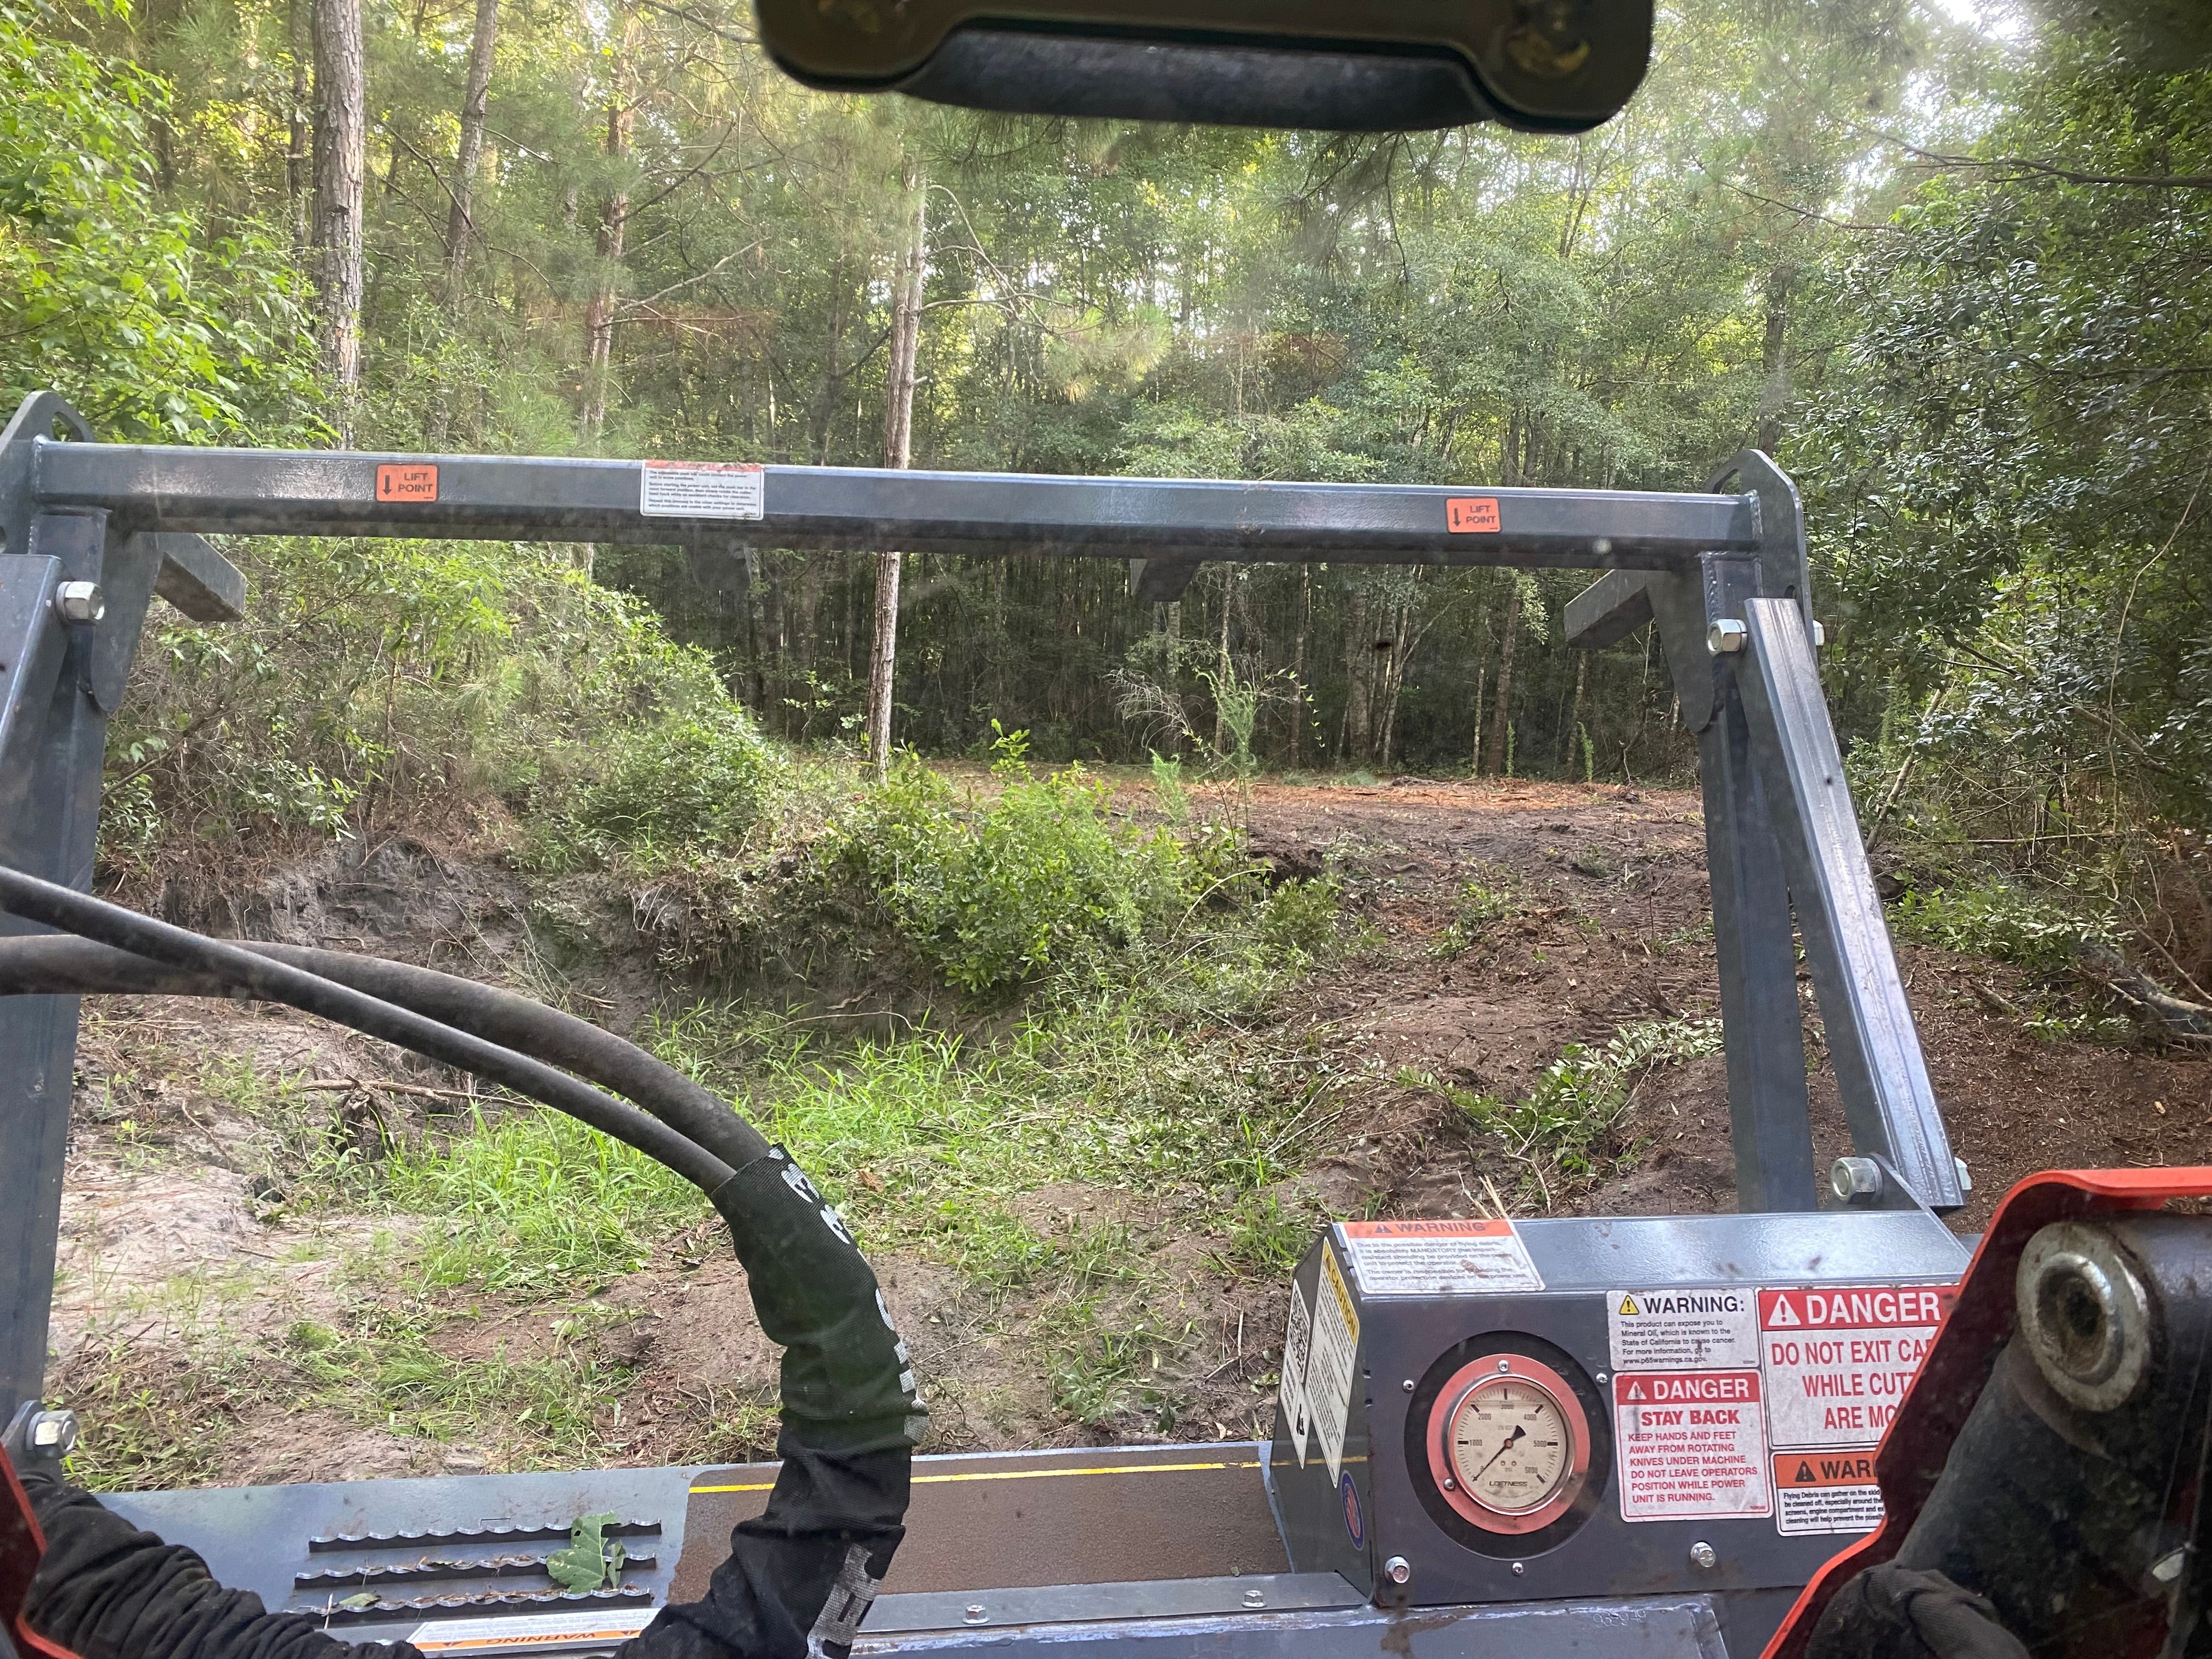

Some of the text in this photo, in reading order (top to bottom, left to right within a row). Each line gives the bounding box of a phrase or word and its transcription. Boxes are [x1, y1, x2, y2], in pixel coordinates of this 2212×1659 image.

[1395, 1222, 1487, 1233] WARNING
[1331, 1268, 1356, 1335] CAUTION
[1643, 1295, 1745, 1314] WARNING:
[1806, 1291, 1942, 1325] DANGER
[1771, 1342, 1800, 1365] DO
[1805, 1341, 1844, 1364] NOT
[1851, 1340, 1892, 1363] EXIT
[1653, 1378, 1750, 1400] DANGER
[1802, 1373, 1864, 1397] WHILE
[1641, 1409, 1740, 1426] STAY BACK
[1824, 1406, 1864, 1429] ARE
[1628, 1431, 1736, 1442] KEEP HANDS AND FEET
[1629, 1443, 1735, 1454] AWAY FROM ROTATING
[1630, 1455, 1746, 1466] KNIVES UNDER MACHINE
[1631, 1467, 1758, 1479] DO NOT LEAVE OPERATORS
[1632, 1479, 1745, 1491] POSITION WHILE POWER
[1633, 1493, 1715, 1503] UNIT IS RUNNING.
[1825, 1498, 1852, 1506] especially
[1809, 1508, 1827, 1516] engine
[486, 1633, 596, 1645] WARNING
